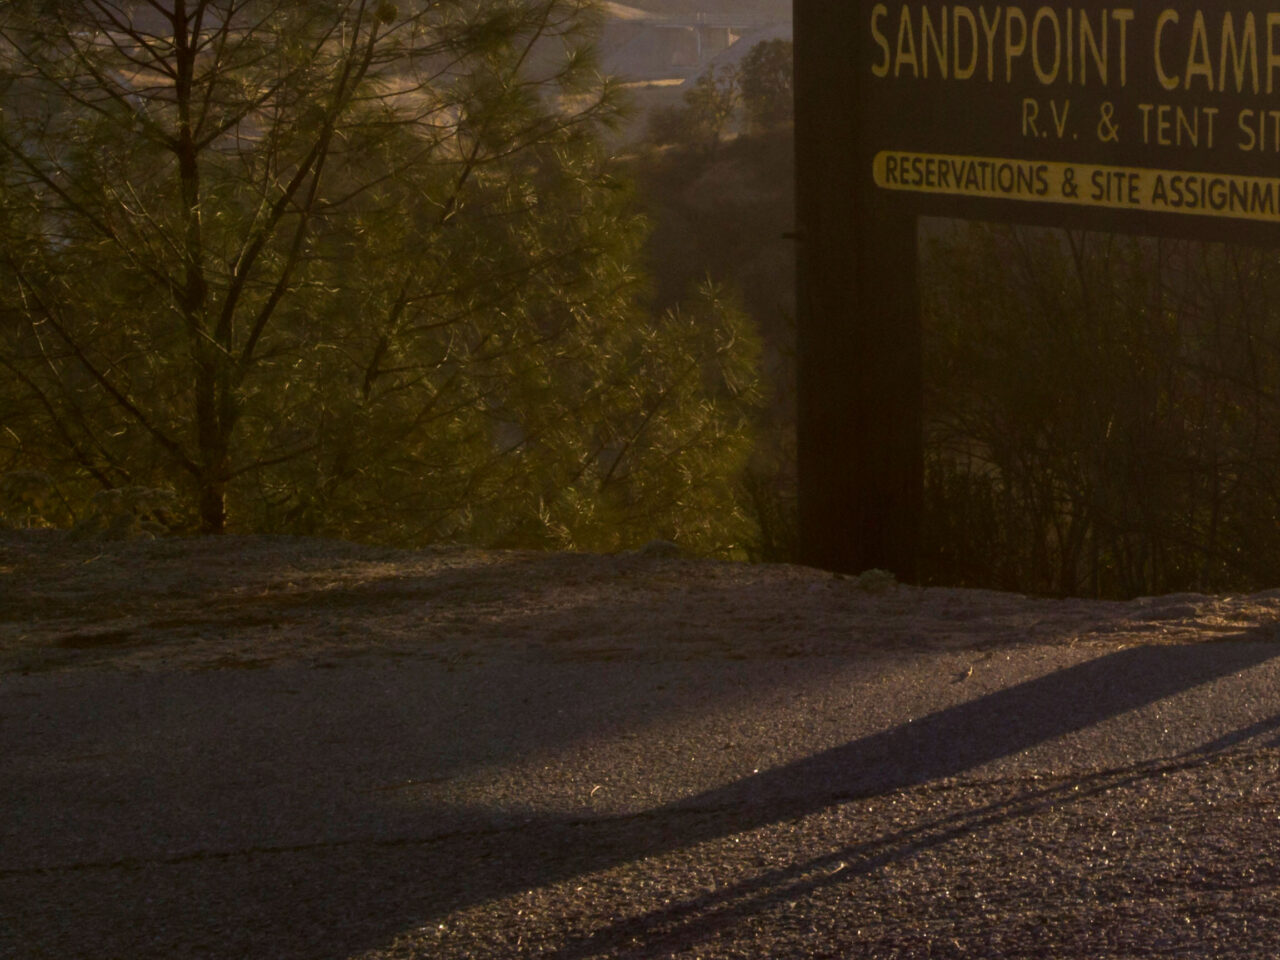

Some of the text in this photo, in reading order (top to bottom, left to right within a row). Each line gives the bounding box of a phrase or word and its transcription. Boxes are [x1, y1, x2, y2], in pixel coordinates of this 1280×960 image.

[870, 3, 1134, 87] SANDYPOINT
[1022, 98, 1078, 139] R.V.
[1097, 101, 1119, 143] &
[1138, 104, 1219, 148] TENT
[885, 155, 1049, 196] RESERVATIONS
[1061, 168, 1079, 198] &
[1091, 170, 1141, 205] SITE
